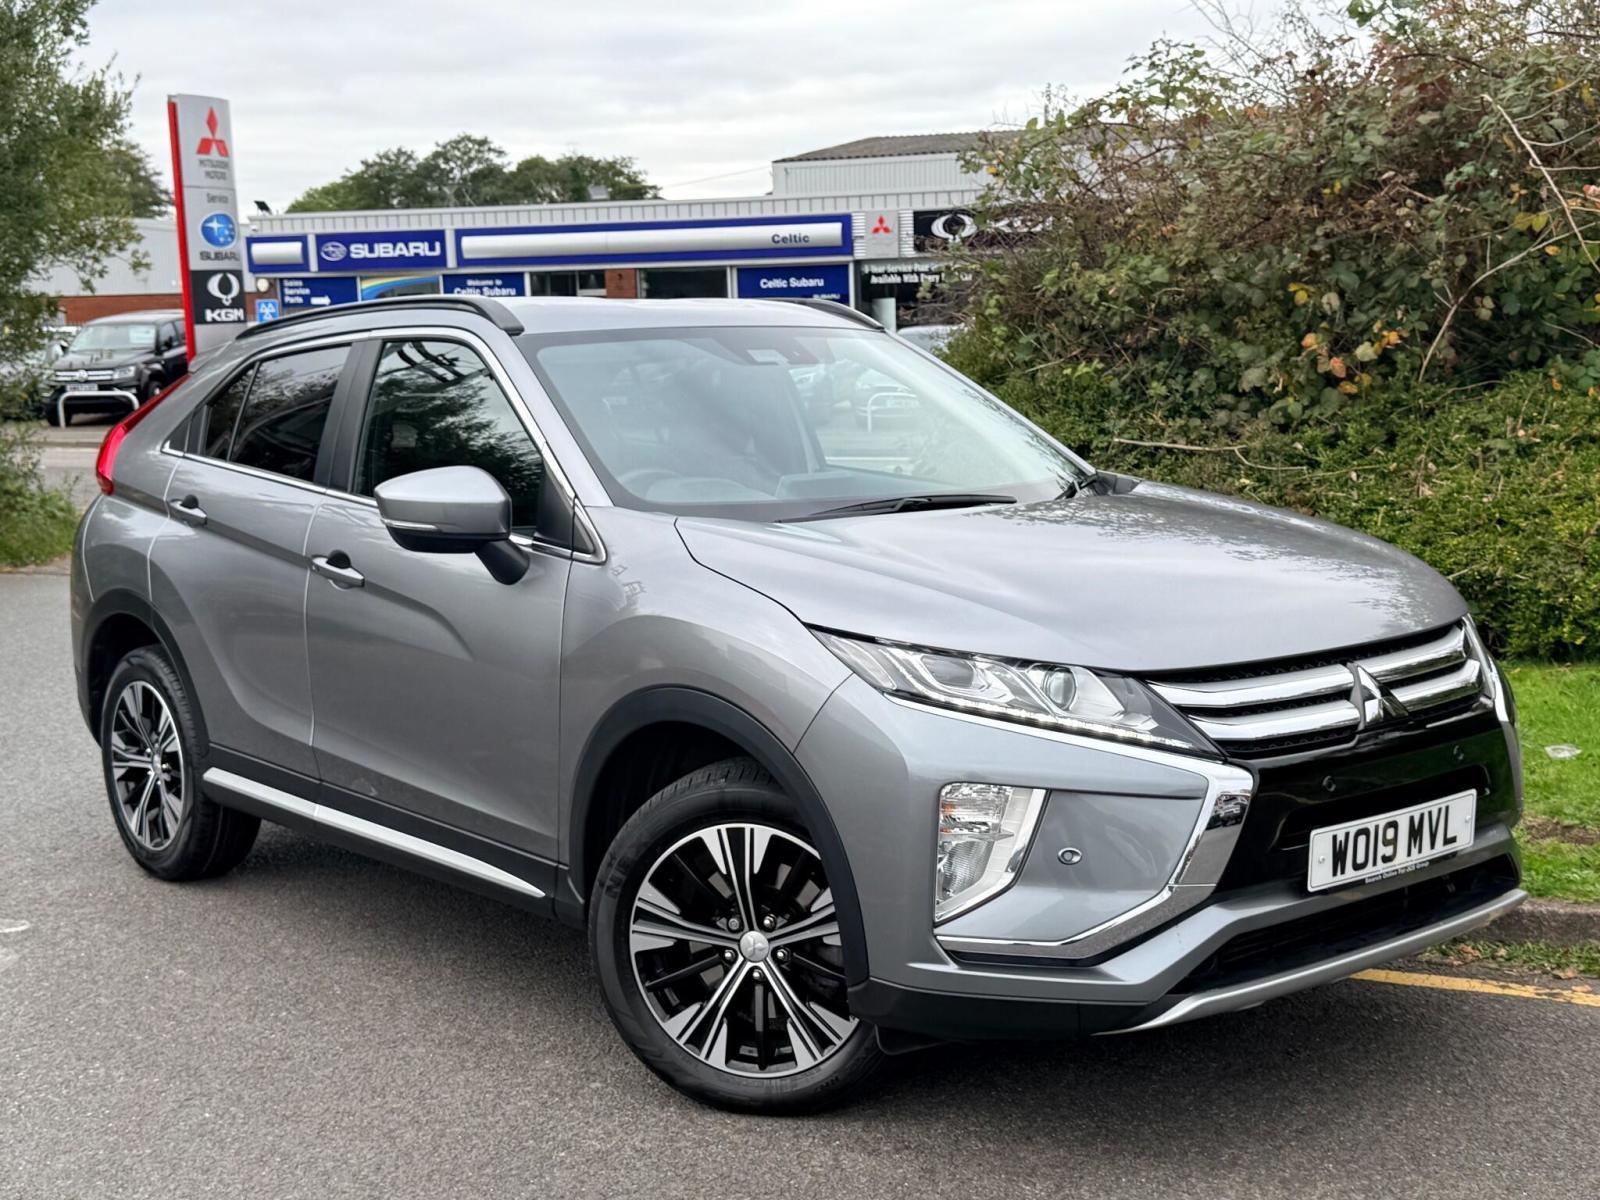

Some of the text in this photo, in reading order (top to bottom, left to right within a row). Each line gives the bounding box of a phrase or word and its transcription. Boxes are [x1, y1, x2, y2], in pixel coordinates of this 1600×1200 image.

[771, 233, 810, 244] Celtic
[349, 241, 441, 259] SUBARU
[760, 277, 825, 289] Celtic Subaru
[454, 287, 517, 296] Celtic Subaru
[205, 308, 244, 322] KGM
[1406, 805, 1457, 857] MVL
